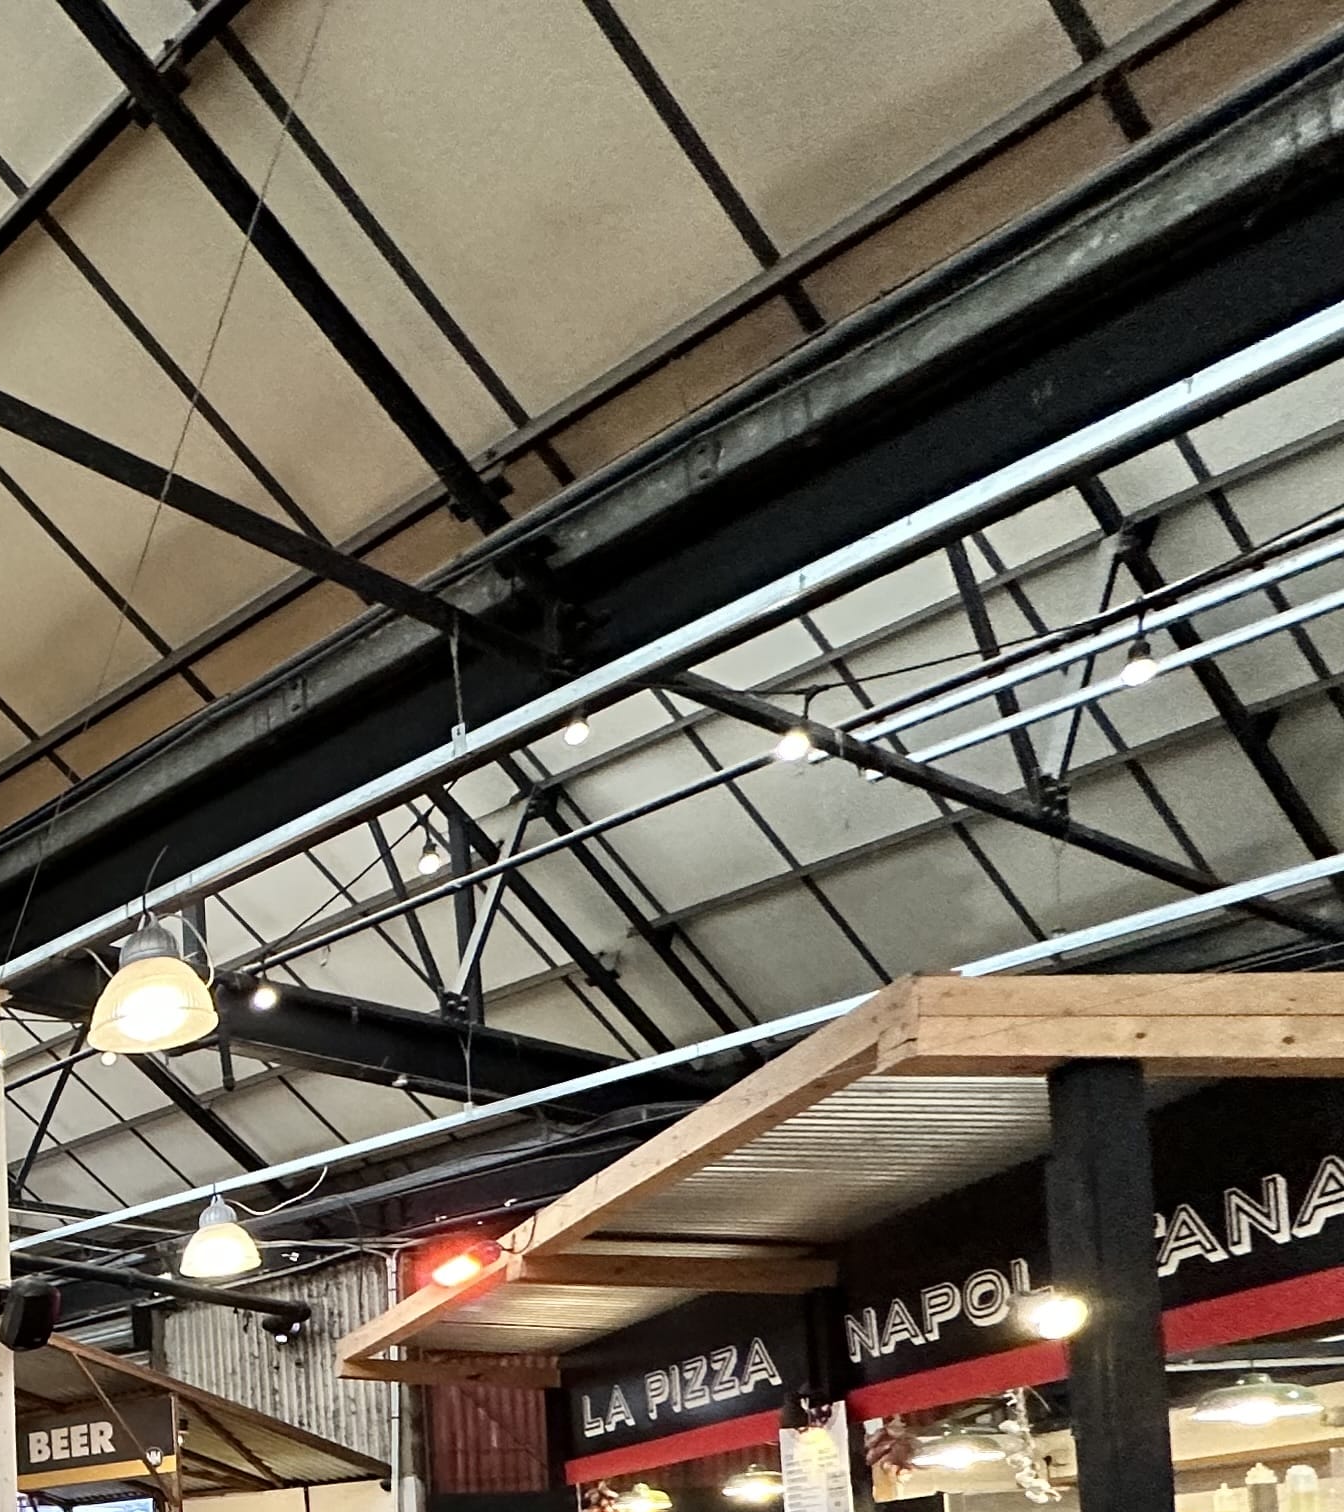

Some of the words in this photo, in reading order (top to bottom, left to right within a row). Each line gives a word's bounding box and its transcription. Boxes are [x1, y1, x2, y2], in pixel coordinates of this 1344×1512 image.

[581, 1384, 636, 1438] LA
[644, 1336, 783, 1420] PIZZA
[28, 1420, 116, 1464] BEER
